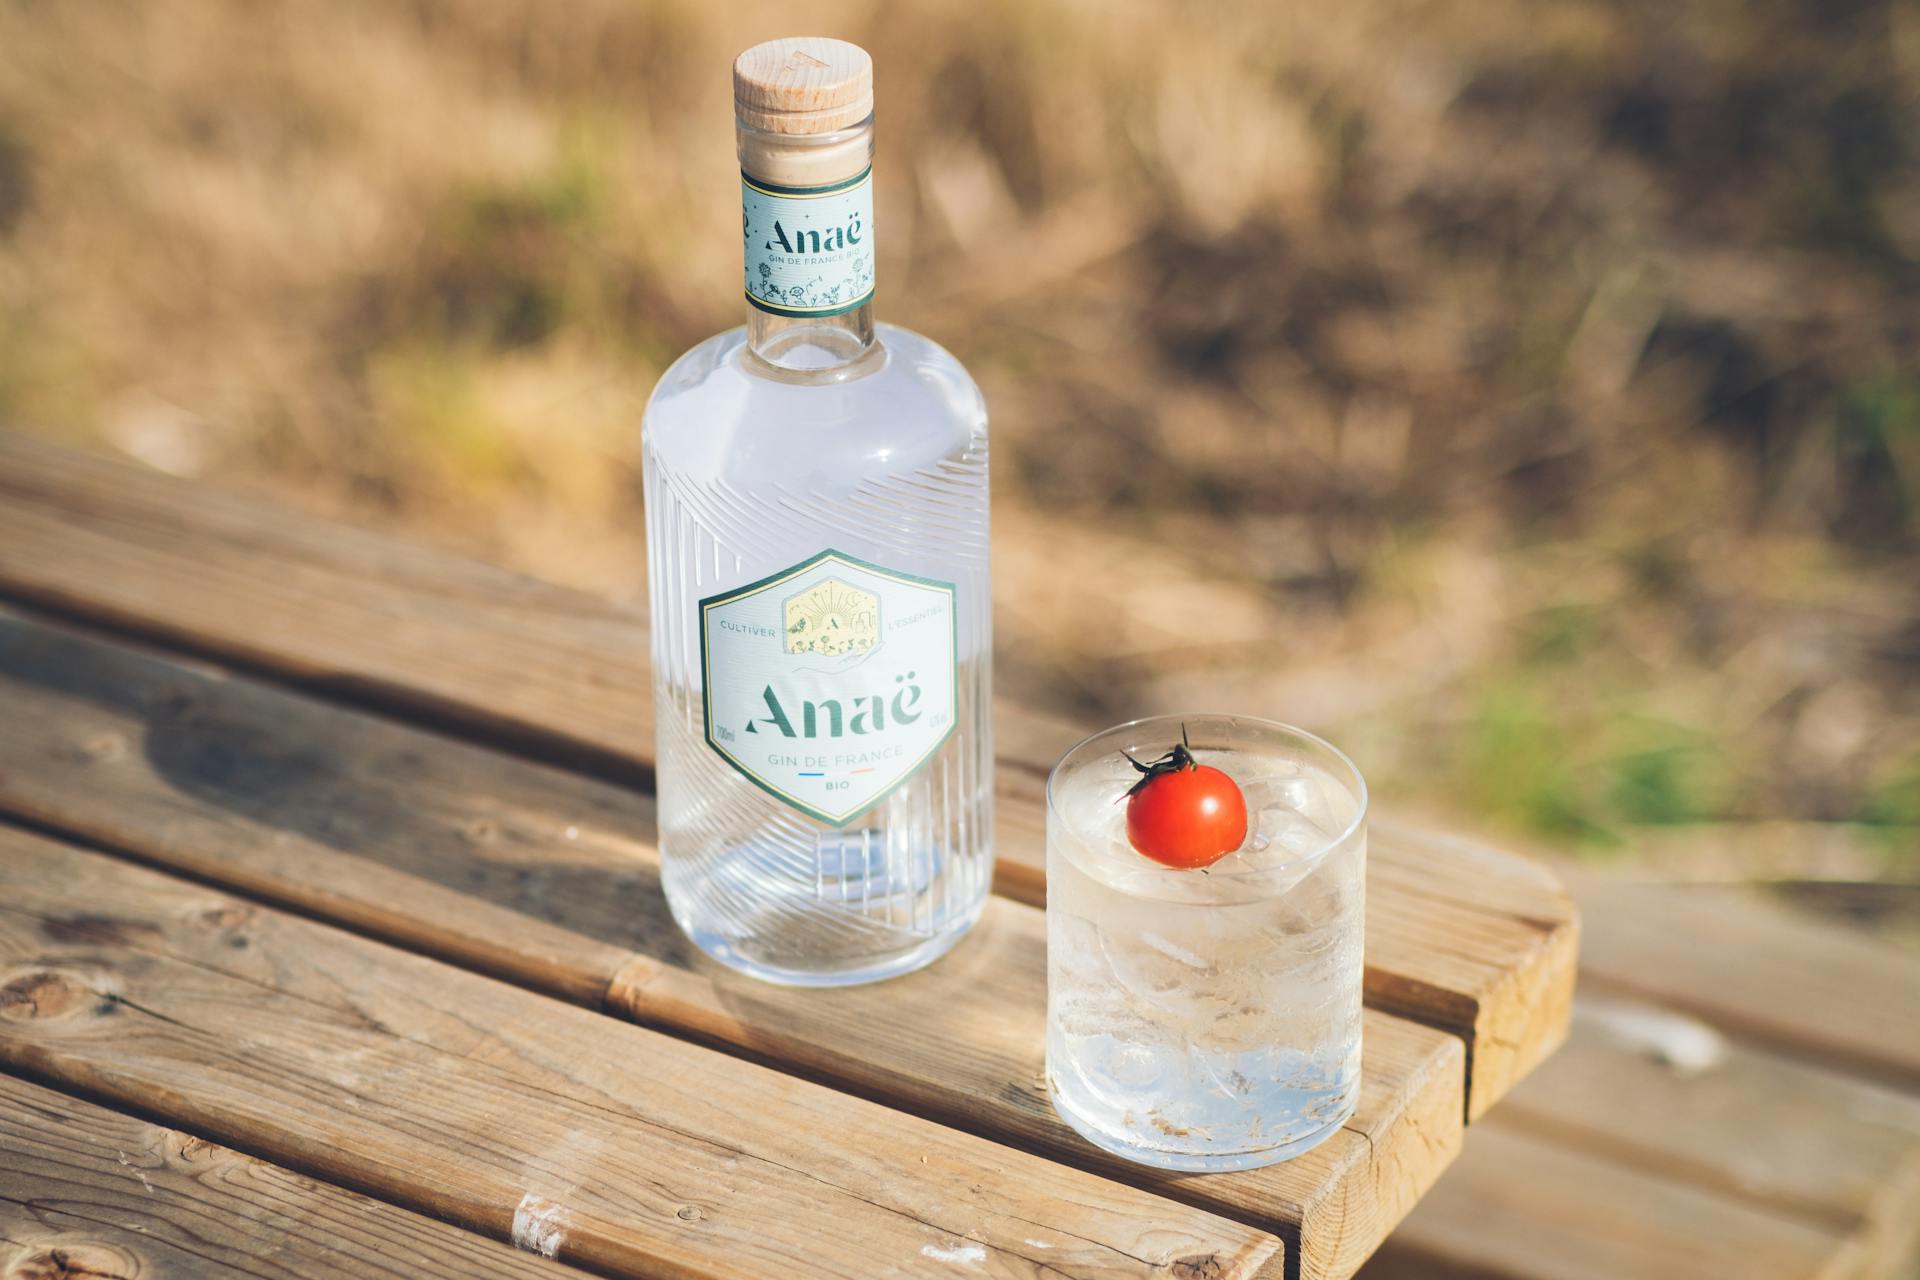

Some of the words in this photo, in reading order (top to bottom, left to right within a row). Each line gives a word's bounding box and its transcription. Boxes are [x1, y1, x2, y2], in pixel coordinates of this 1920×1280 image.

[765, 211, 862, 254] Anaë
[768, 254, 785, 265] GIN
[788, 255, 801, 265] DE
[804, 254, 844, 265] FRANCE
[720, 619, 777, 639] CULTIVER
[745, 671, 923, 739] Anaë
[767, 753, 798, 767] GIN
[804, 754, 828, 768] DE
[835, 745, 904, 767] FRANCE
[825, 781, 850, 791] BIO
